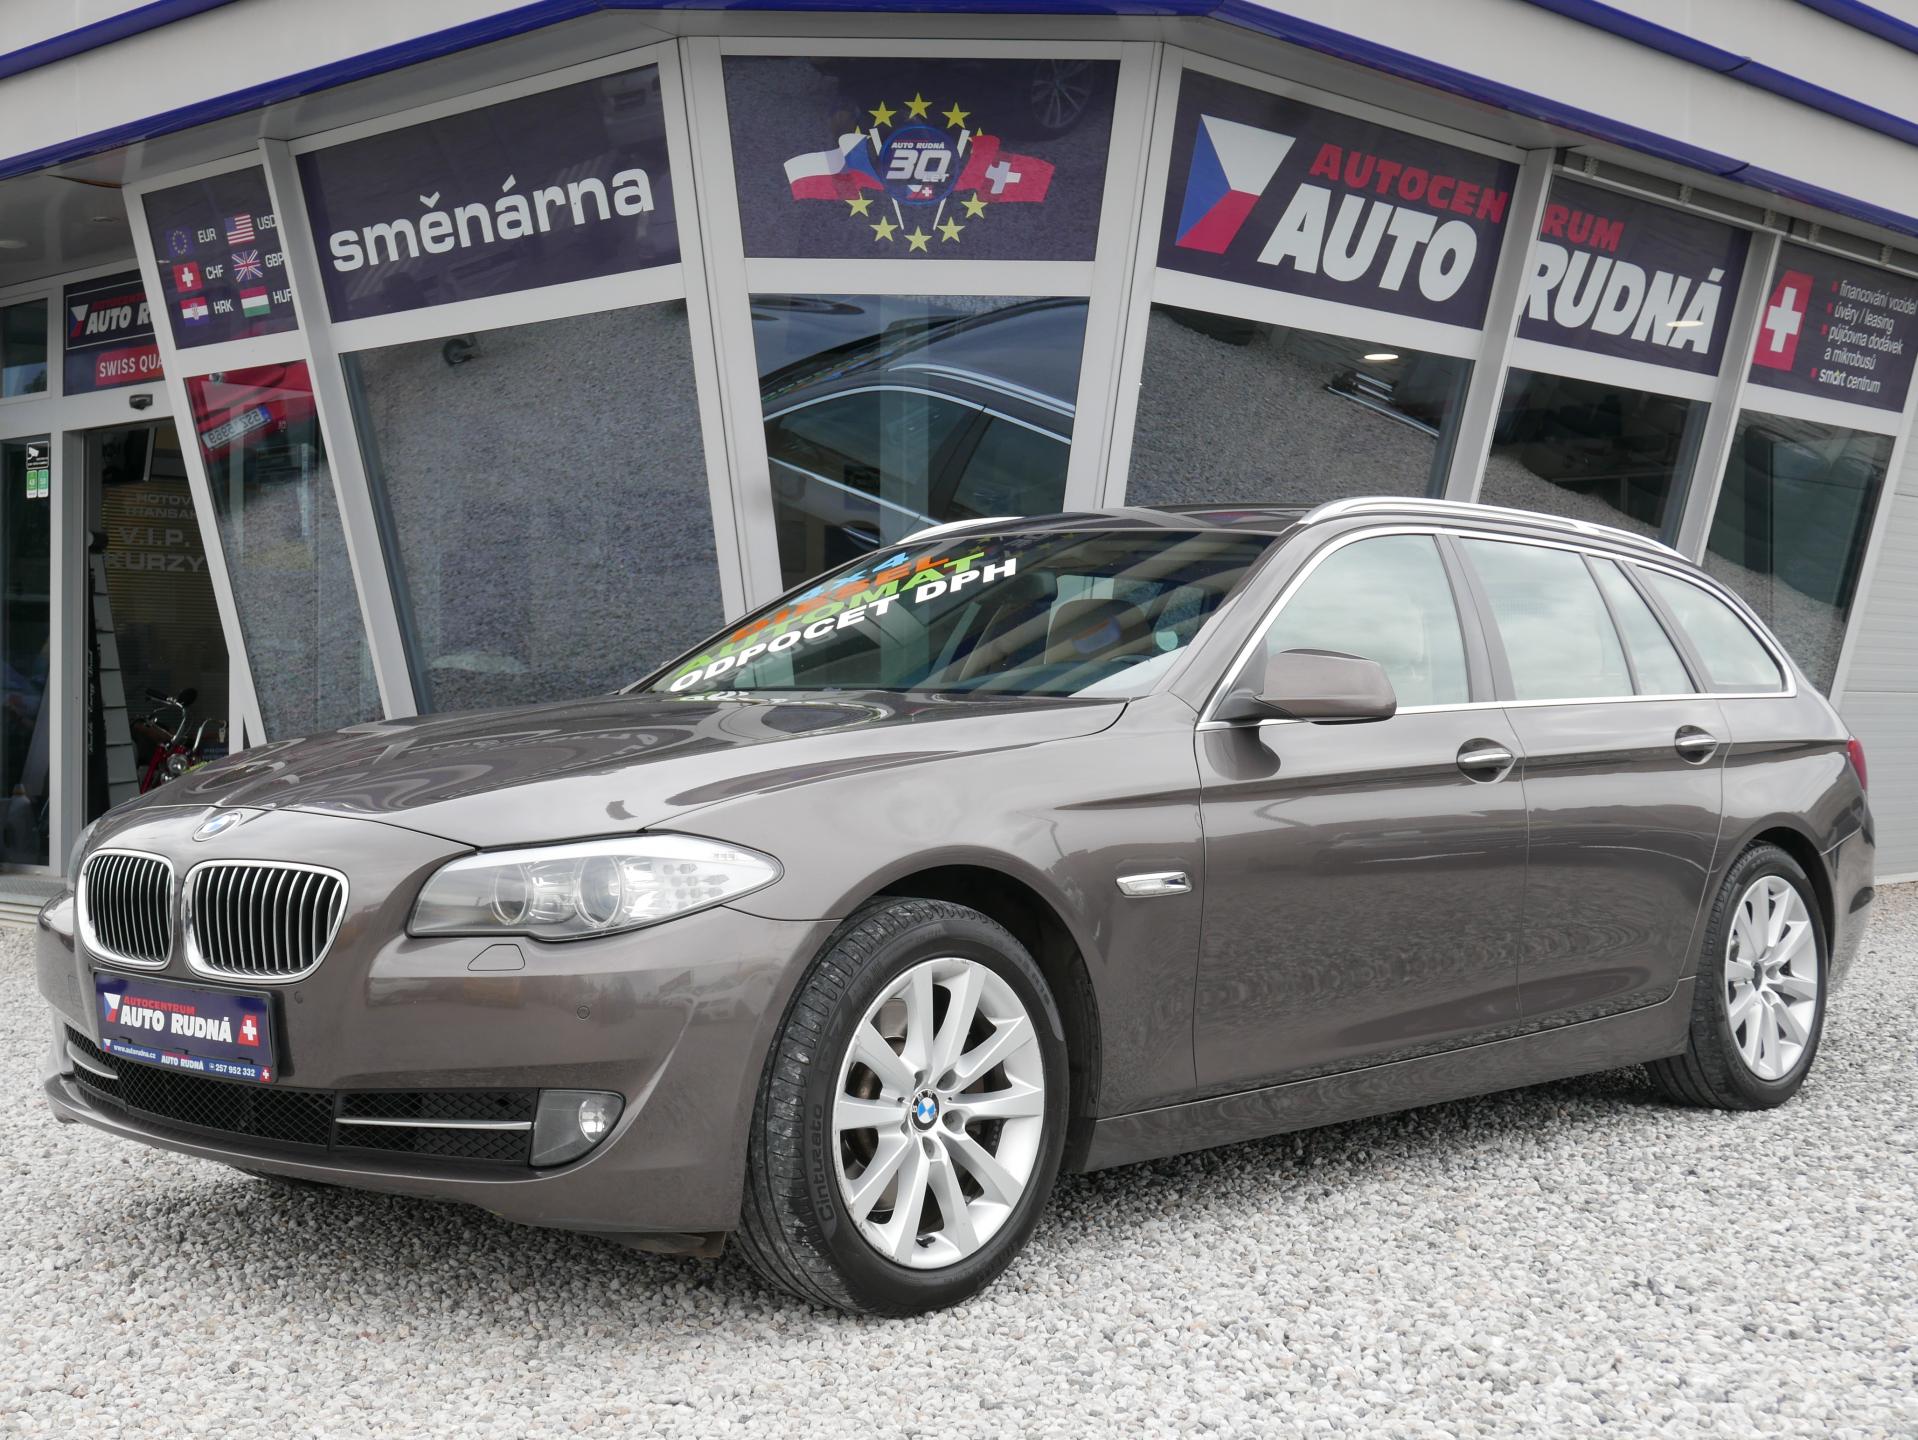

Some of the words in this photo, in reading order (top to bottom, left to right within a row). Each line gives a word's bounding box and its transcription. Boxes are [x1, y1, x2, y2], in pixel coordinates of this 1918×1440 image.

[886, 149, 951, 180] 30
[1308, 143, 1509, 224] AUTOCEN
[197, 228, 217, 243] EUR
[256, 214, 278, 230] USD
[329, 168, 655, 272] směnárna
[205, 264, 224, 279] CHF
[264, 252, 284, 268] GBP
[1257, 182, 1478, 302] AUTO
[1519, 239, 1726, 355] RUDNÁ
[213, 299, 234, 314] HRK
[272, 288, 293, 304] HUF
[1840, 280, 1890, 307] financování
[1889, 293, 1917, 316] vozidel
[85, 305, 132, 336] AUTO
[1834, 302, 1859, 325] úvěry
[1863, 309, 1895, 335] leasing
[1824, 347, 1831, 360] a
[1868, 332, 1904, 355] dodávek
[99, 357, 136, 377] SWISS
[1846, 373, 1881, 394] centrum
[670, 594, 900, 692] ODPOCET
[914, 557, 1017, 603] DPH
[672, 552, 985, 681] AUTOMAT
[123, 994, 196, 1015] AUTOCENTRUM
[120, 1004, 165, 1032] AUTO
[171, 1012, 232, 1043] RUDNÁ
[161, 1055, 178, 1066] AUTO
[215, 1065, 227, 1073] 257
[228, 1066, 241, 1075] 952
[242, 1068, 256, 1077] 332
[810, 1103, 835, 1221] Cinturato
